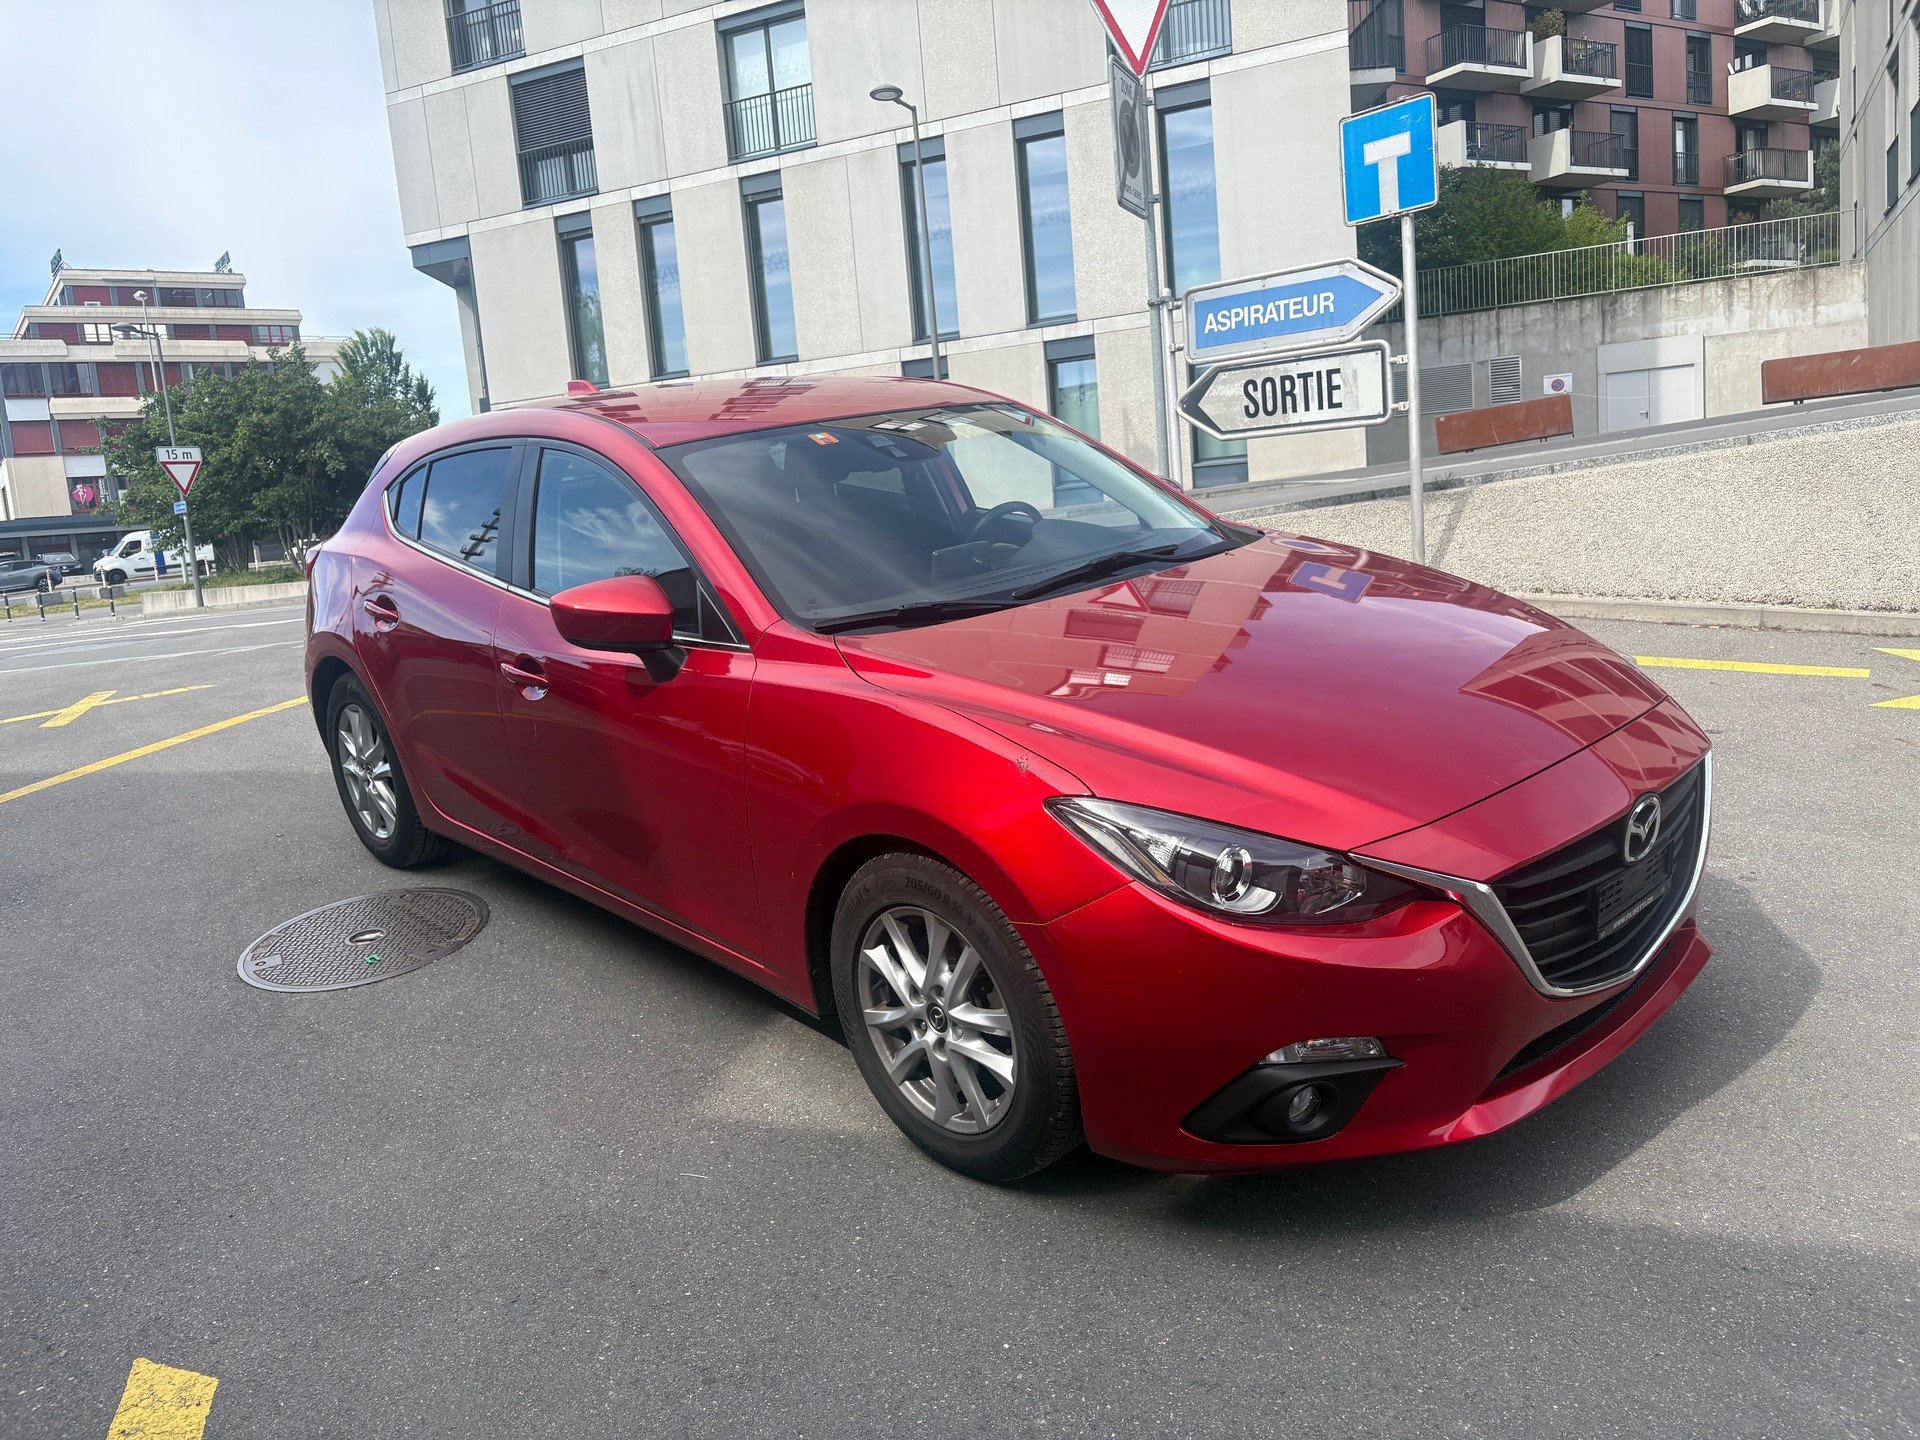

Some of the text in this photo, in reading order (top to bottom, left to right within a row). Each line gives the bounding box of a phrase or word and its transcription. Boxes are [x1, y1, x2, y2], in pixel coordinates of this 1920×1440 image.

[1203, 291, 1335, 334] ASPIRATEUR
[1243, 368, 1343, 419] SORTIE
[165, 449, 193, 460] 15 m
[904, 876, 942, 900] 205/60
